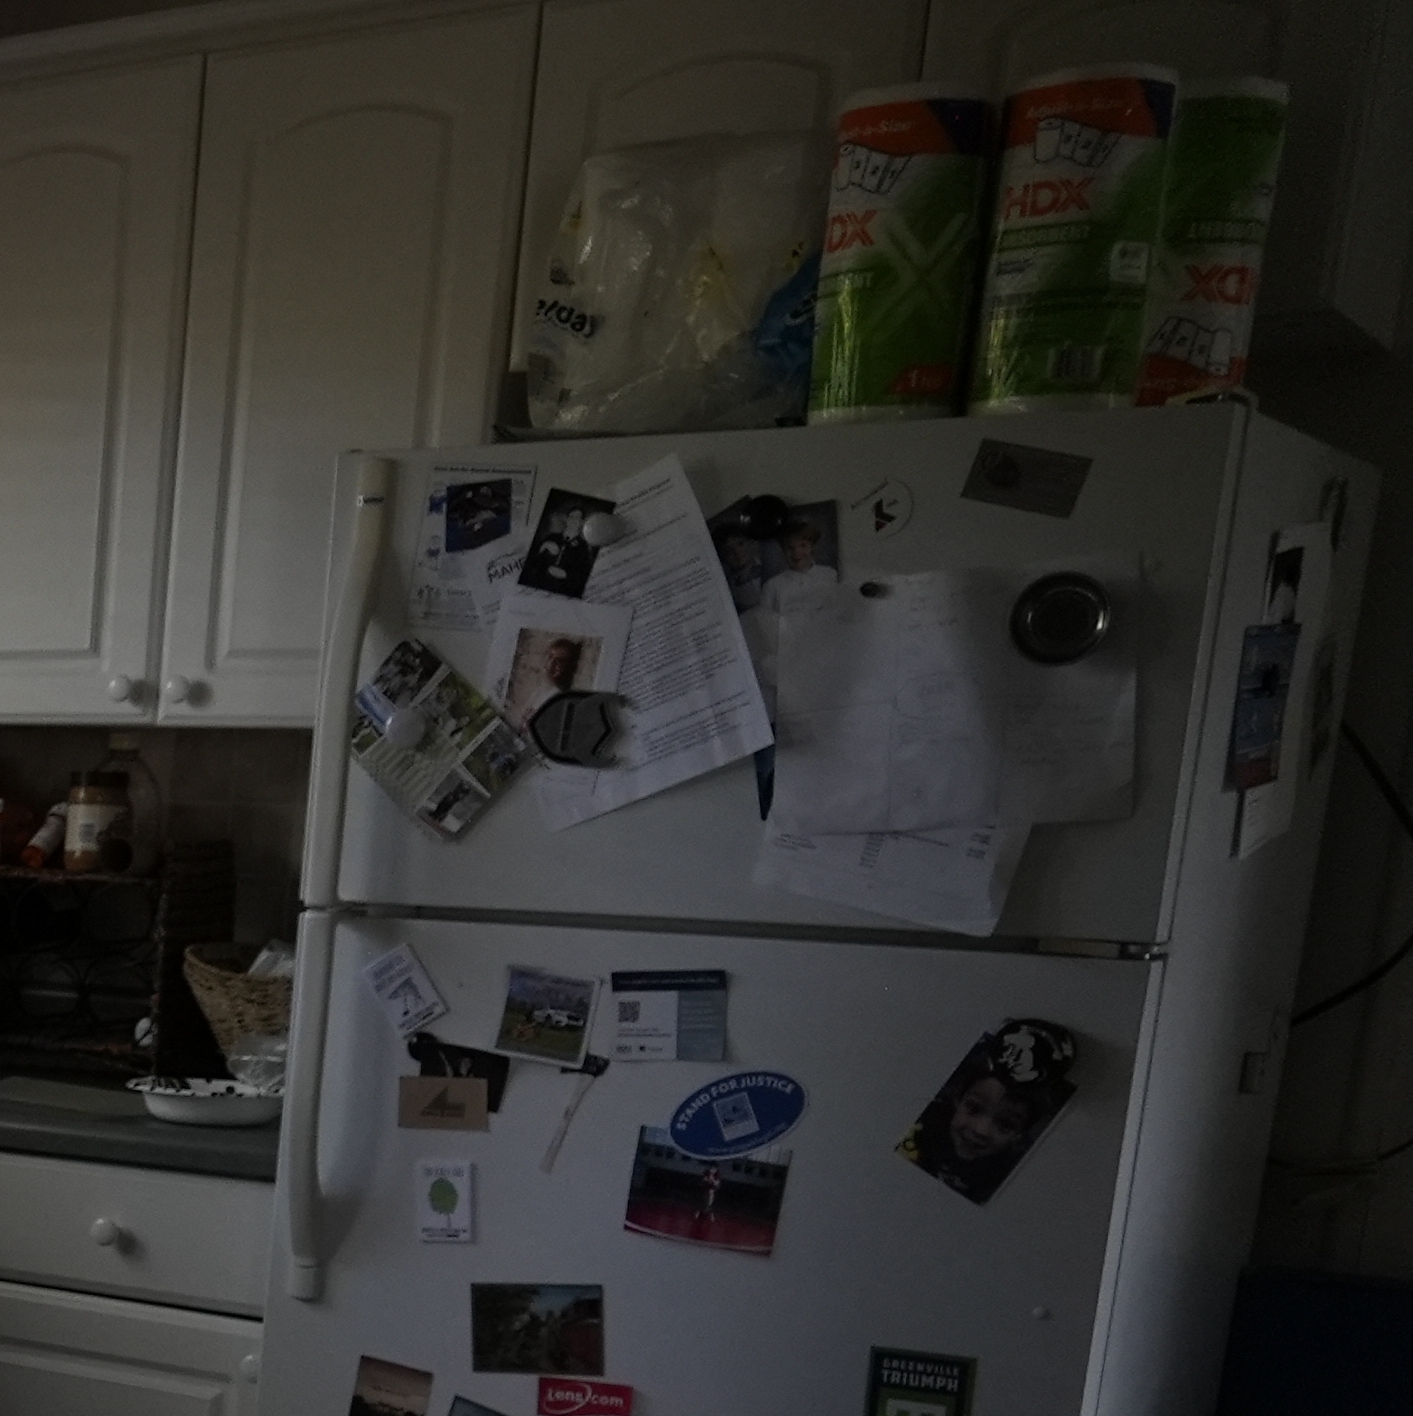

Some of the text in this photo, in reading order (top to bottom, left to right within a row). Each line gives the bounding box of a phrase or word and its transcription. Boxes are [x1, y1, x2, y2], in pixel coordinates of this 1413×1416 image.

[1005, 177, 1095, 220] HDX
[826, 210, 877, 253] DX
[1180, 264, 1254, 304] DX
[675, 1074, 797, 1131] STAND FOR JUSTICE
[881, 1369, 960, 1393] TRIUMPH
[882, 1357, 960, 1376] GREENVILLE
